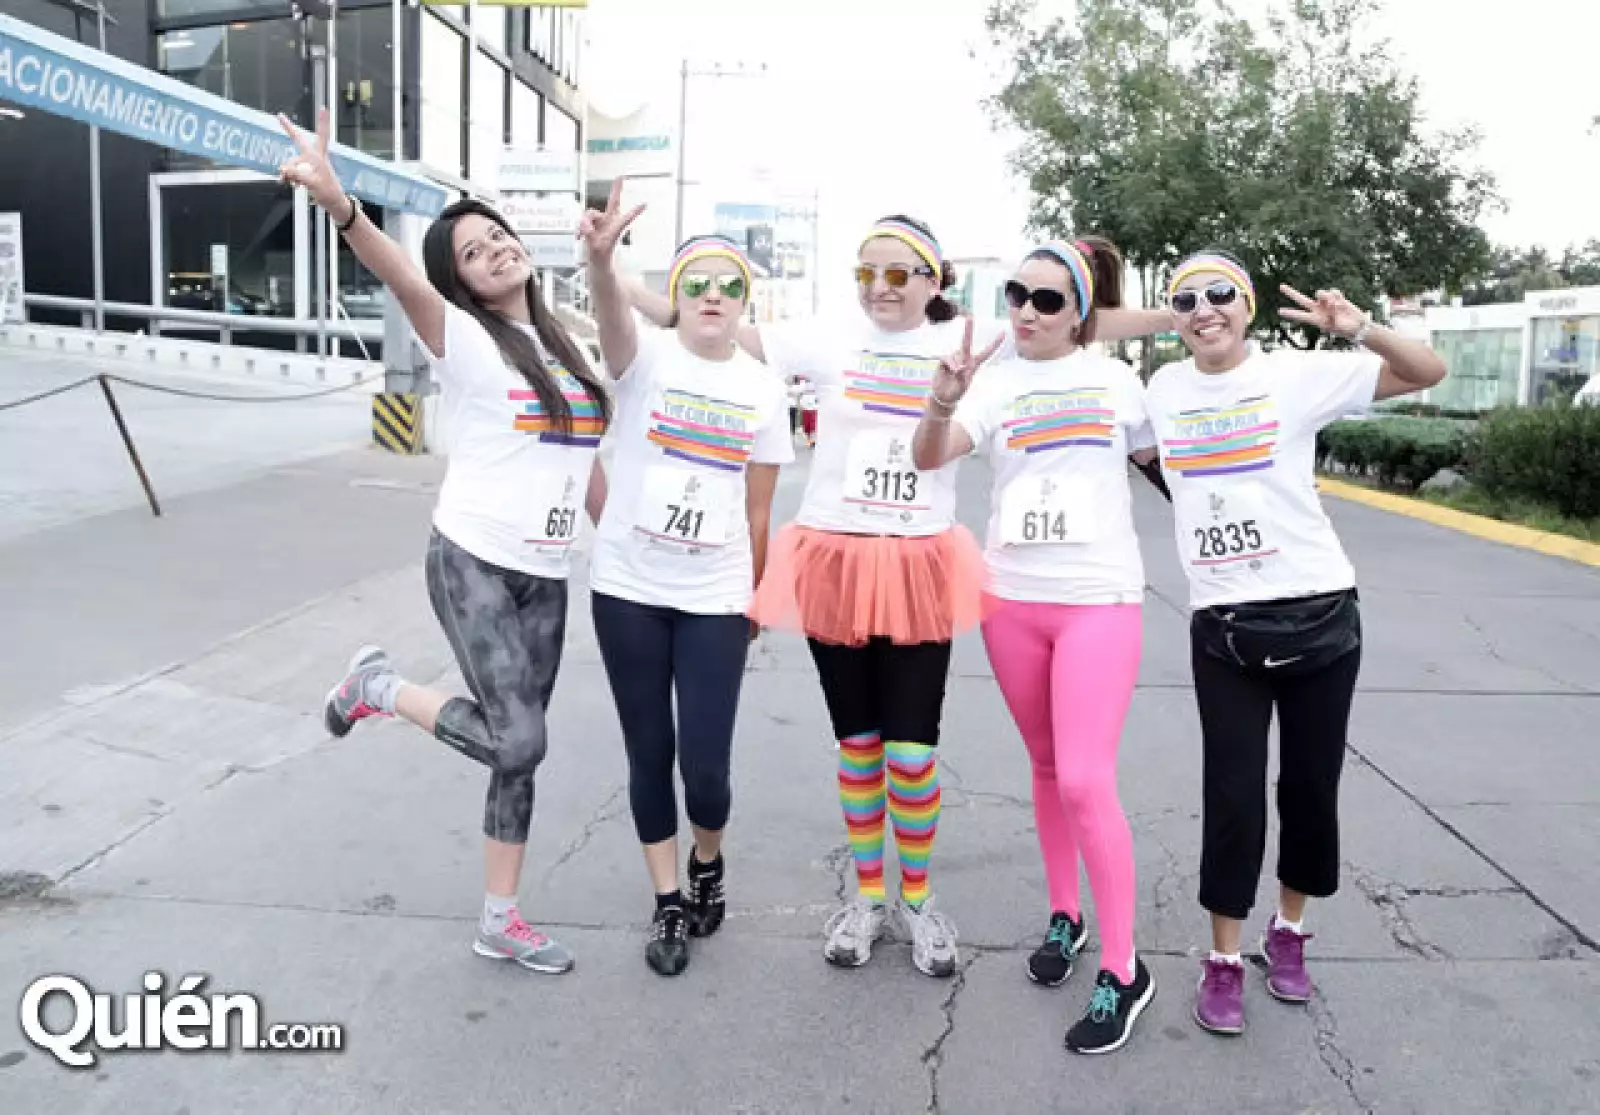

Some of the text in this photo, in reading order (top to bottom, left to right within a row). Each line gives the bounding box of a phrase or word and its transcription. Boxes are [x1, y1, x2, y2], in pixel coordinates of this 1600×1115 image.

[0, 47, 198, 142] ACIONAMIENTO
[862, 467, 918, 502] 3113
[545, 507, 576, 538] 661
[664, 504, 704, 538] 741
[1022, 510, 1067, 541] 614
[1194, 519, 1262, 558] 2835
